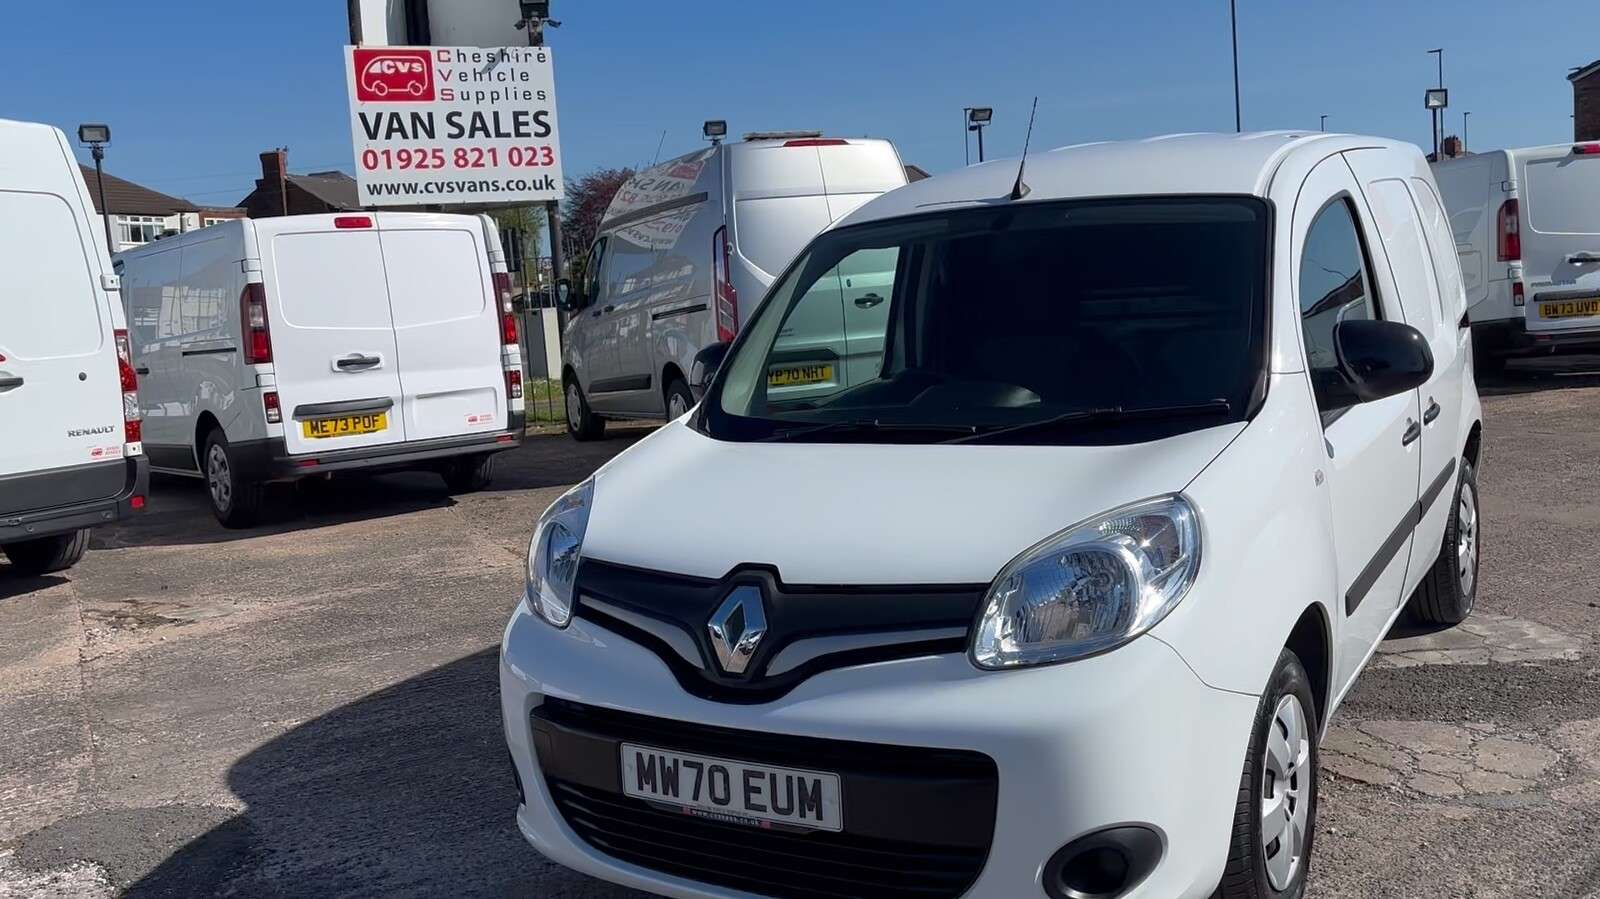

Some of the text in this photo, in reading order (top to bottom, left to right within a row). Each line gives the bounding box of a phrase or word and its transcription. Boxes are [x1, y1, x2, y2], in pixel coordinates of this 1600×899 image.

[437, 48, 546, 63] Cheshire
[381, 60, 423, 74] CVS
[437, 68, 530, 82] Vehicle
[440, 86, 546, 105] Supplies
[358, 110, 552, 140] VAN SALES
[362, 146, 554, 170] 01925 821 023
[366, 174, 556, 195] www.cvsvans.co.uk
[802, 365, 826, 379] NHT
[66, 425, 115, 438] RENAULT
[310, 414, 379, 435] ME73 POF
[636, 751, 823, 821] MW70 EUM
